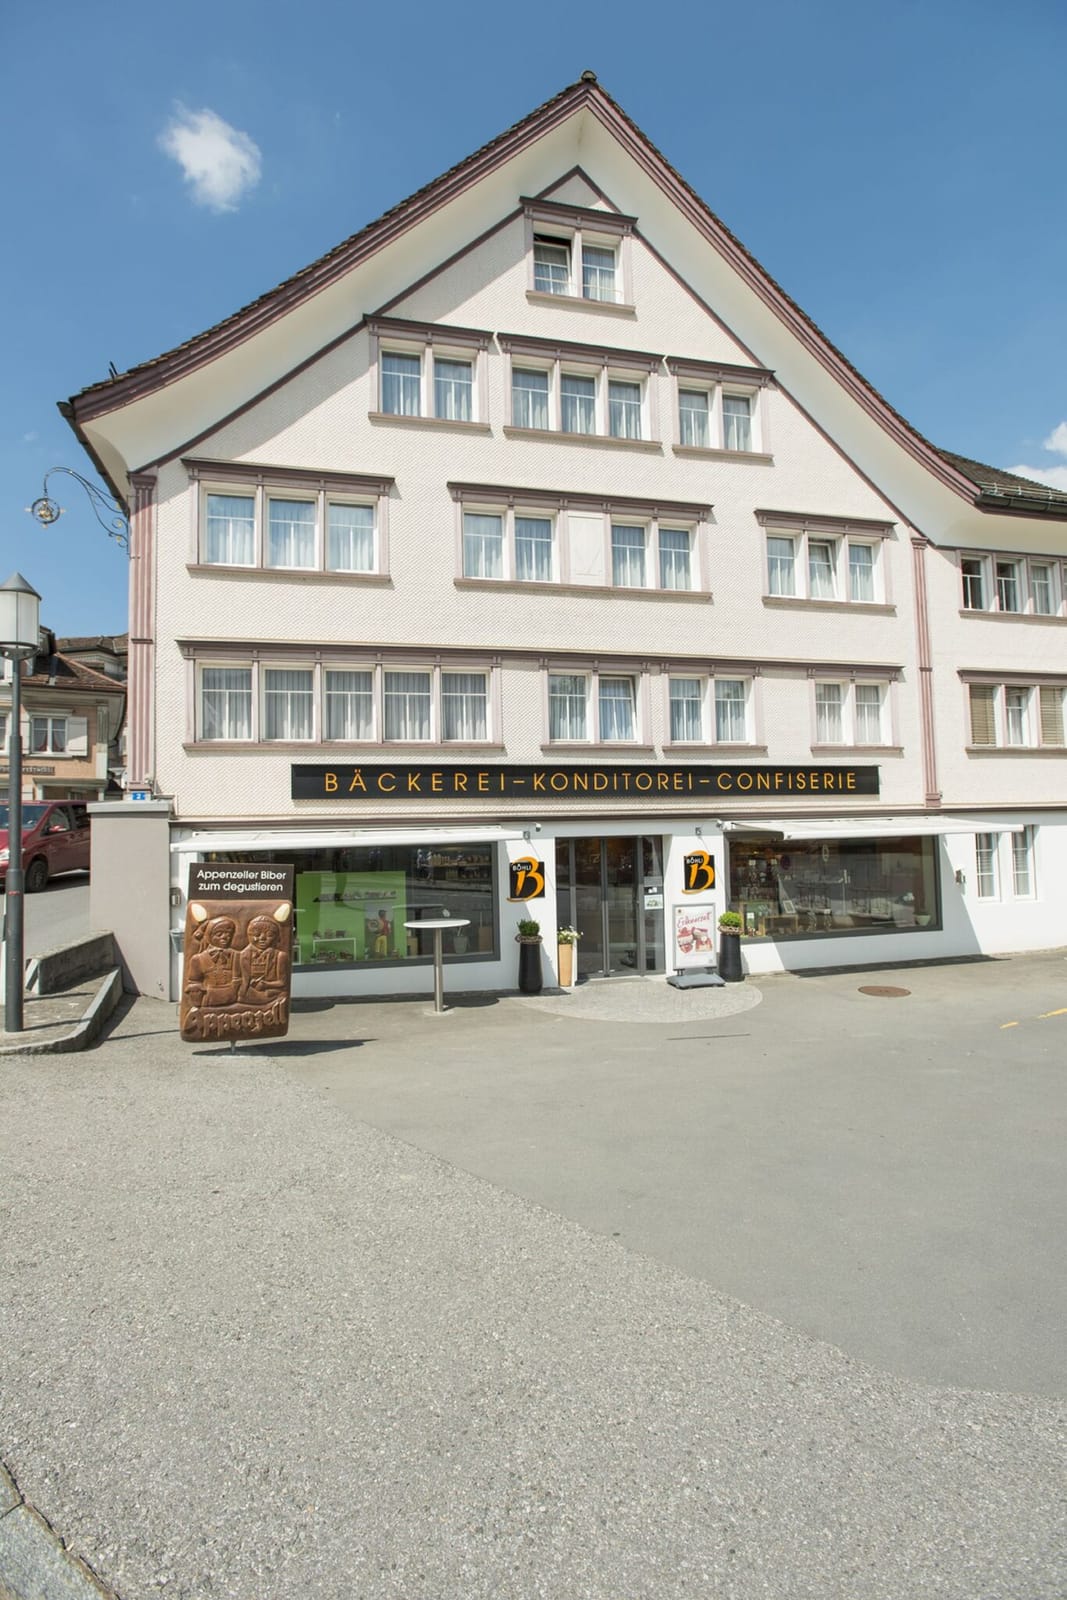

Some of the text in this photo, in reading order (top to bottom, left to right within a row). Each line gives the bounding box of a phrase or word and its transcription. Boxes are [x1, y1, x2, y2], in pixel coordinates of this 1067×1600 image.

[512, 863, 531, 871] BÖHLI
[196, 869, 287, 880] Appenzeller Biber
[198, 881, 283, 893] zum degustieren
